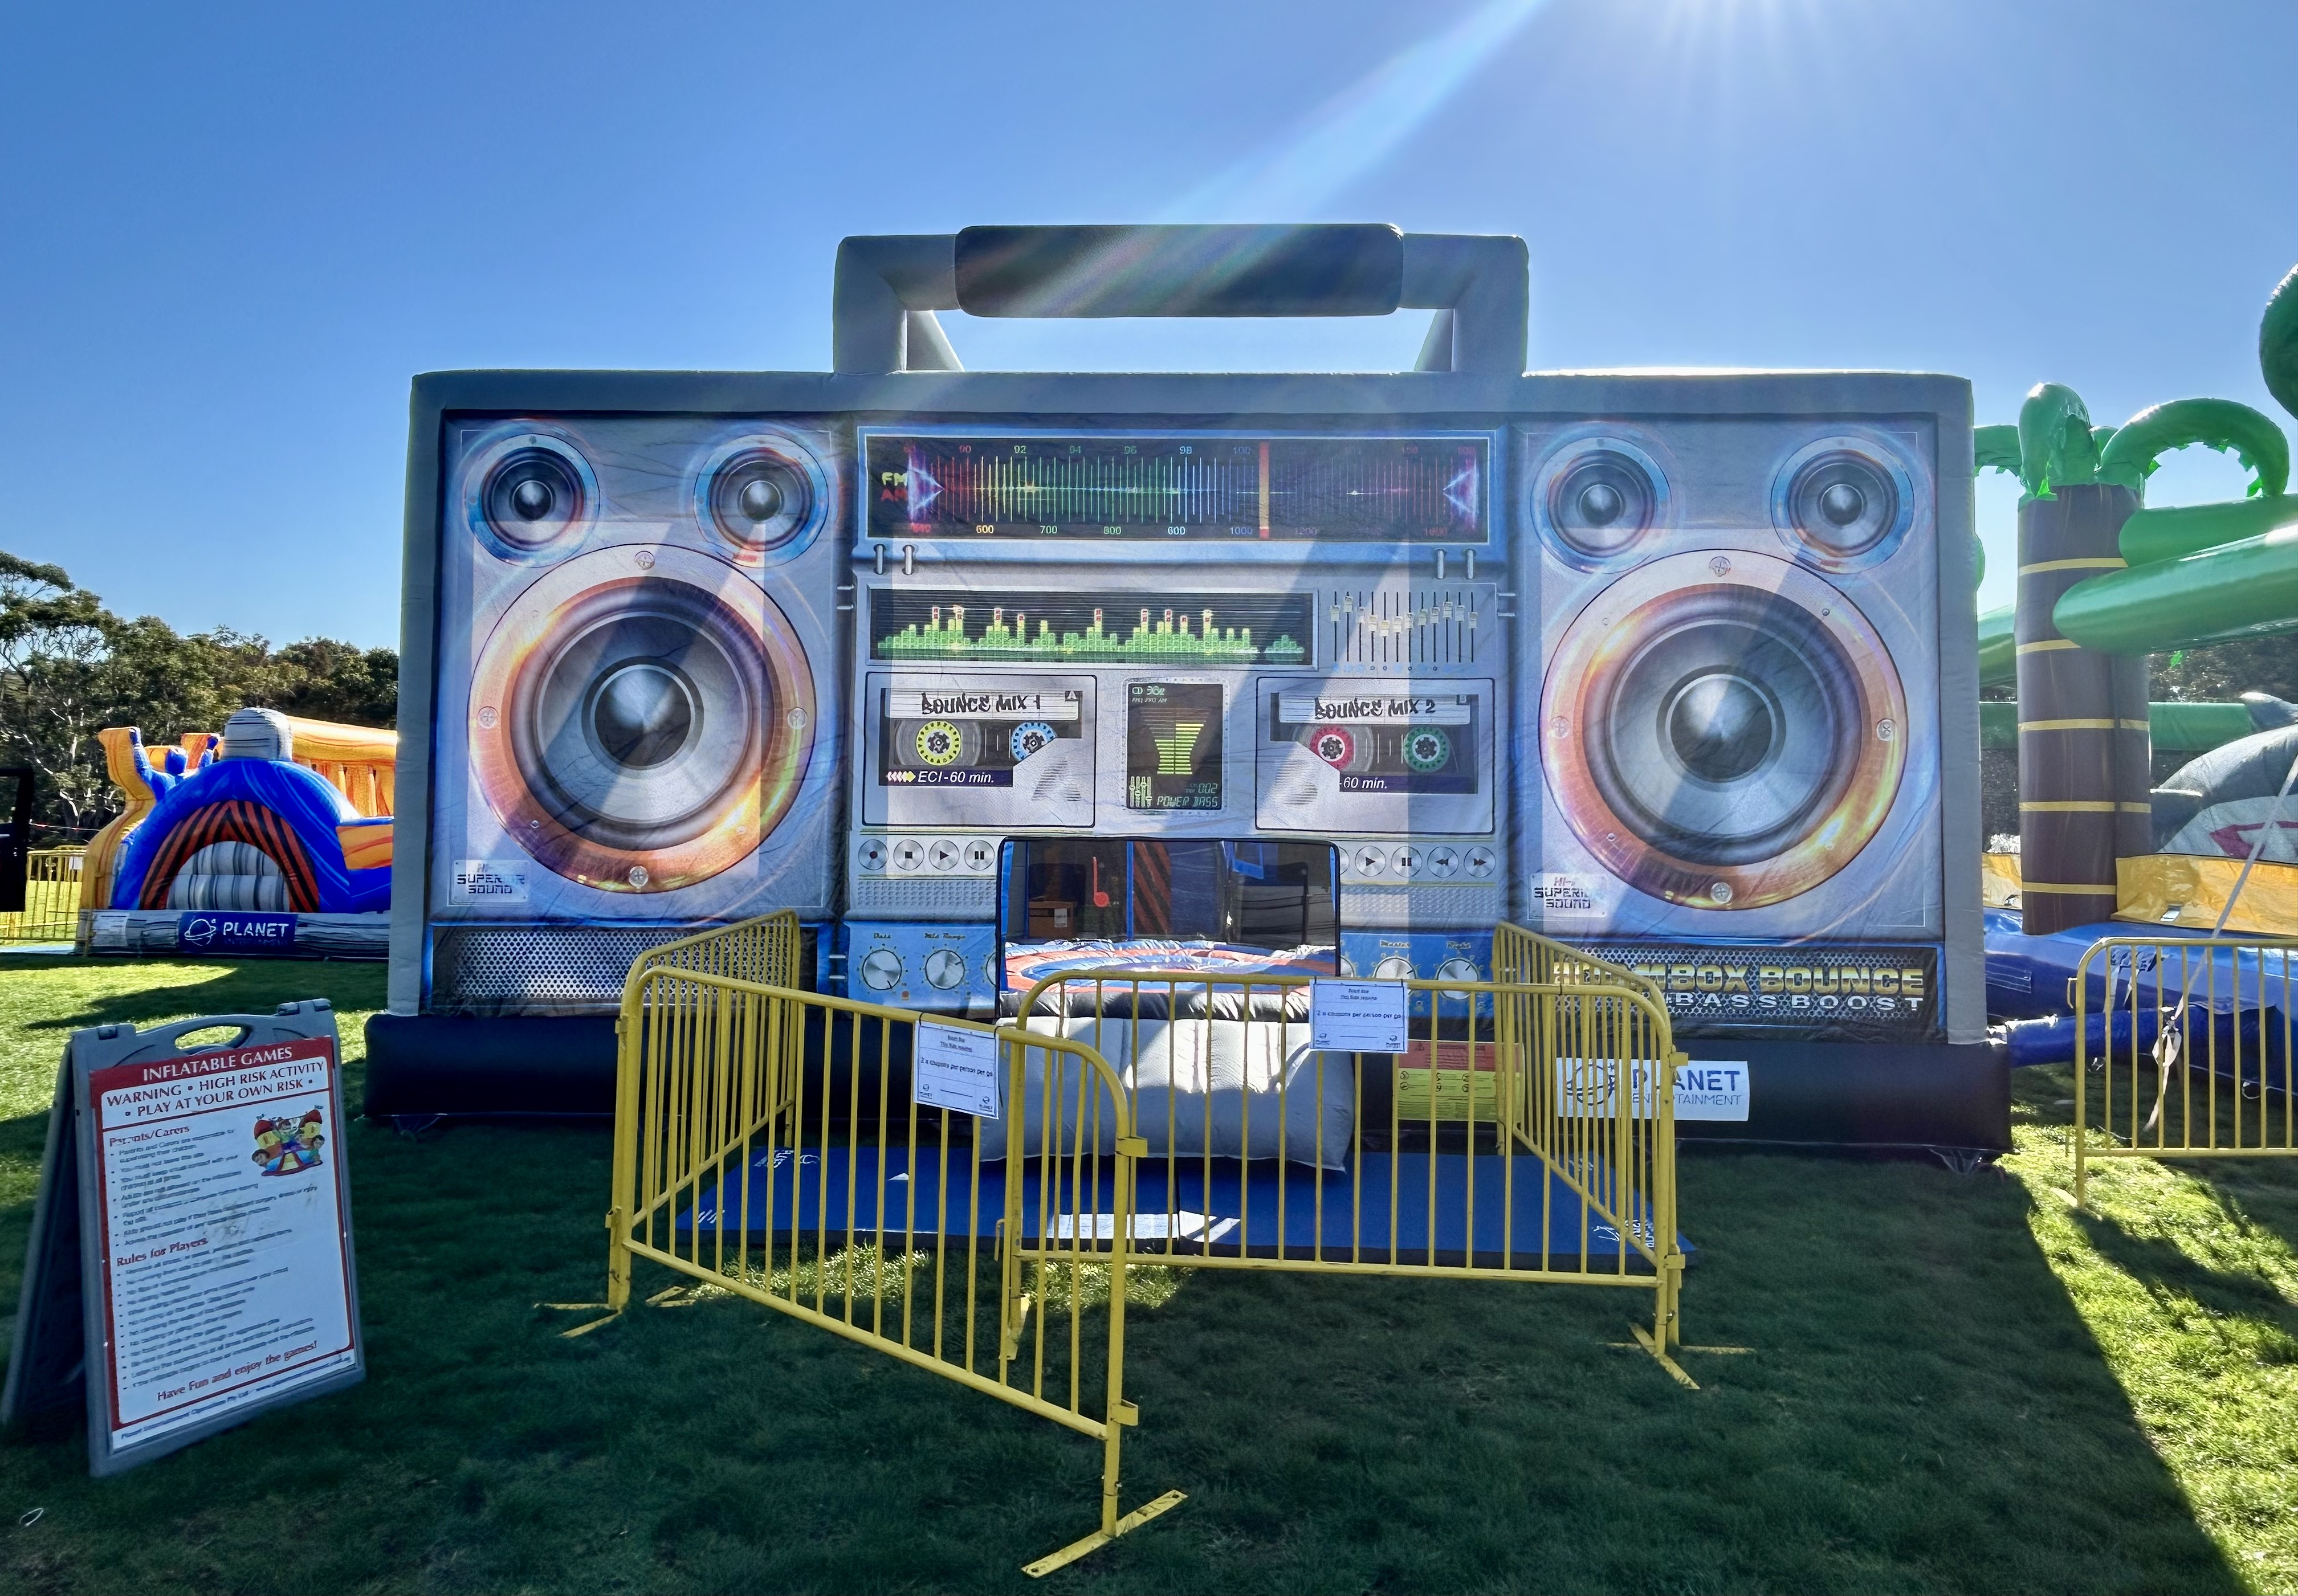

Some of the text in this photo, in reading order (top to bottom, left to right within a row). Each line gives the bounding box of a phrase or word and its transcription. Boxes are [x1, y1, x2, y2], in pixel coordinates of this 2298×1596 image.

[882, 472, 907, 487] FM
[1040, 525, 1058, 534] 700
[922, 691, 991, 715] BOUNCE
[996, 694, 1029, 713] MIX
[1314, 697, 1436, 720] BOUNCE MIX 2
[969, 770, 994, 783] min.
[1362, 777, 1388, 789] min.
[1156, 795, 1218, 807] POWER BASS
[468, 884, 512, 894] SOUND
[1545, 899, 1591, 909] SOUND
[223, 922, 289, 937] PLANET
[1760, 964, 1925, 996] BOUNCE
[1791, 995, 1924, 1011] BOOST
[144, 1047, 292, 1081] INFLATABLE GAMES
[107, 1062, 324, 1107] WARNING HIGH RISK ACTIVITY
[1633, 1069, 1741, 1092] PANET
[137, 1078, 304, 1116] PLAY AT YOUR OWN RISK
[117, 1237, 209, 1266] Rules for Players
[157, 1340, 317, 1402] Have Fun and enjoy the games!
